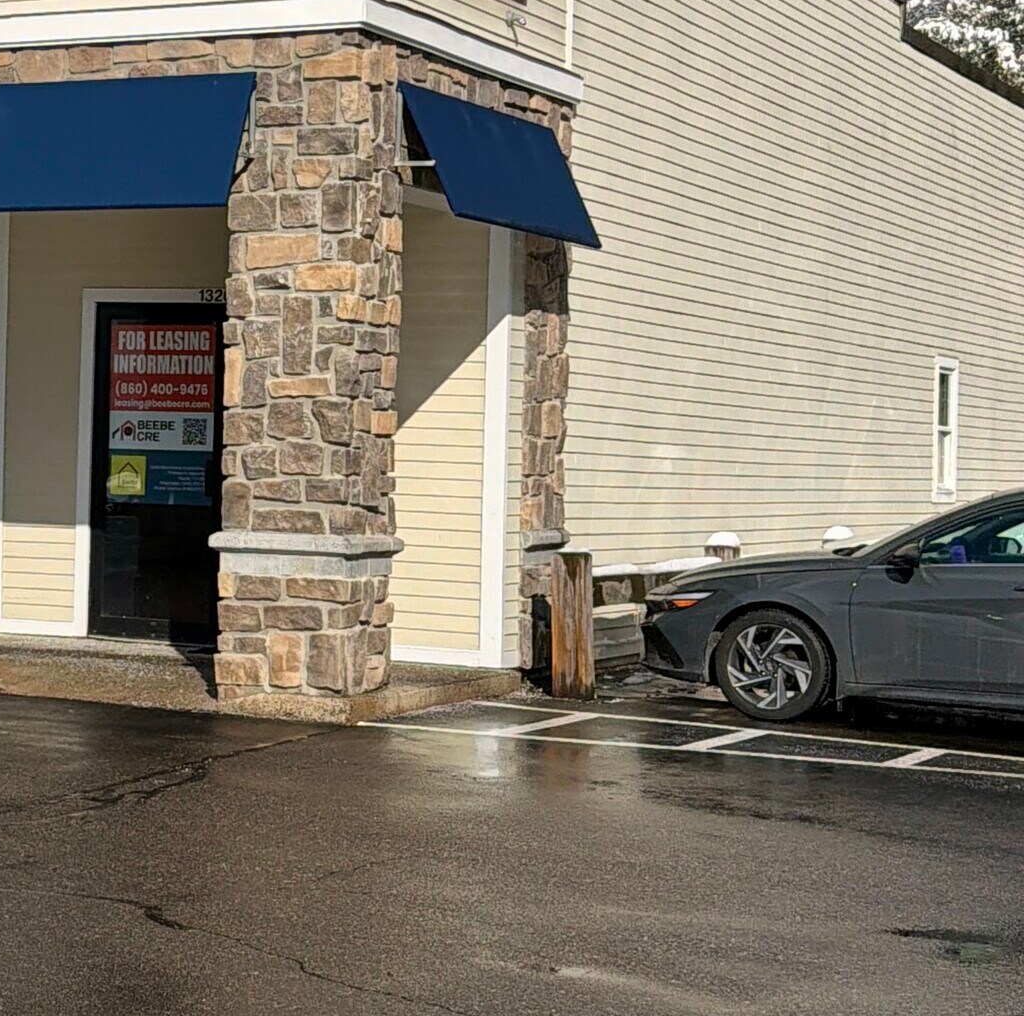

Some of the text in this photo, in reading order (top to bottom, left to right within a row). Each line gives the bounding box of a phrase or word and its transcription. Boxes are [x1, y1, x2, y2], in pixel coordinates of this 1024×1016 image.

[118, 330, 210, 351] FOR LEASING
[113, 354, 214, 375] INFORMATION
[115, 380, 208, 397] (860) 400-9476
[137, 420, 175, 431] BEEBE
[137, 431, 160, 442] CRE
